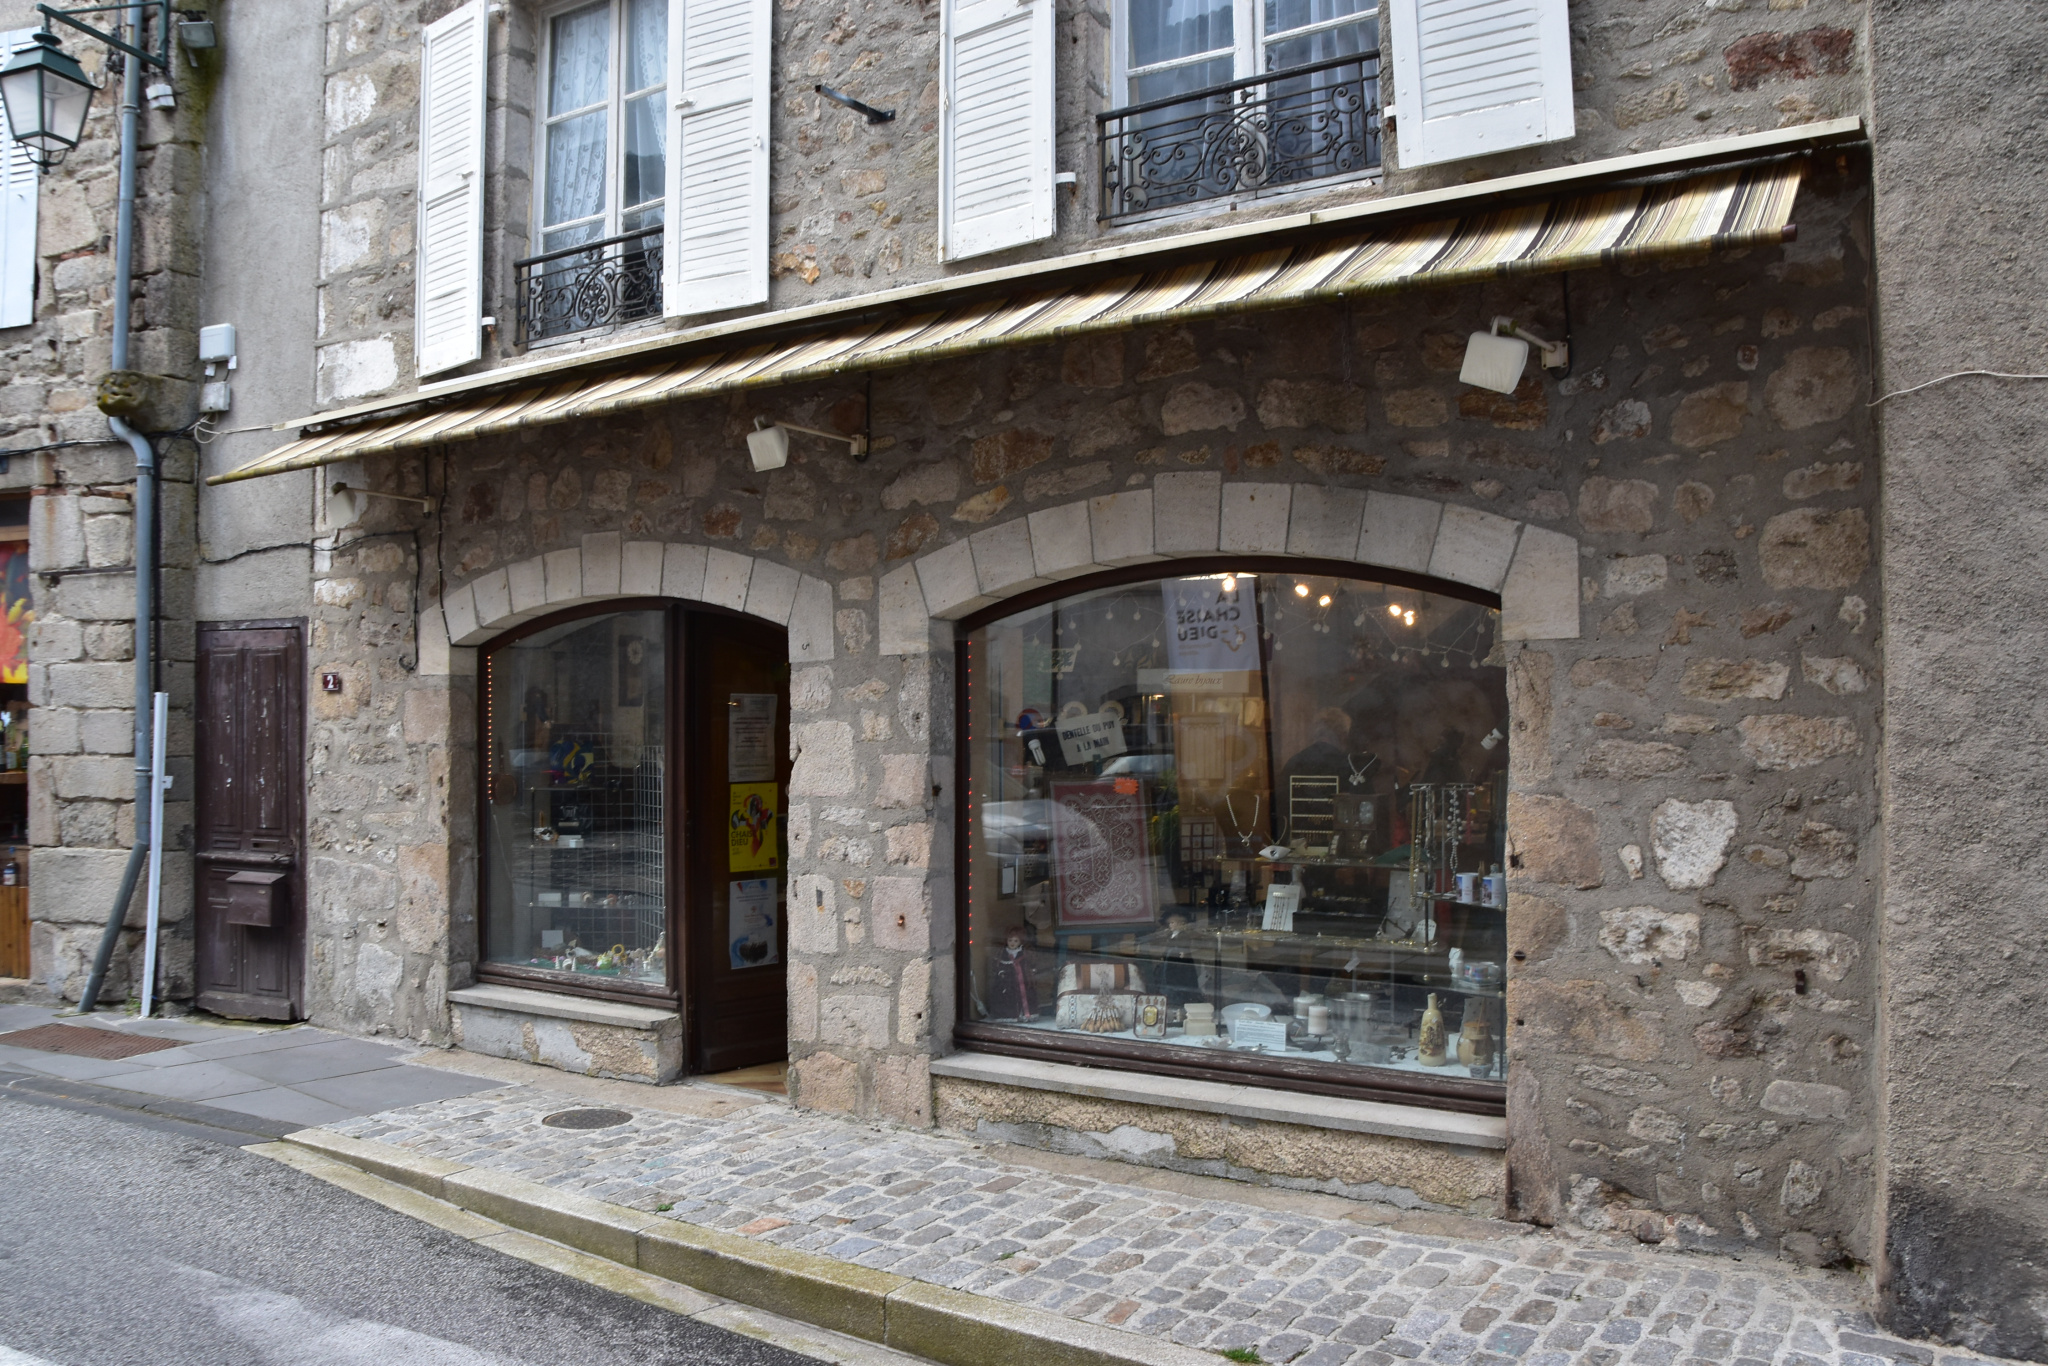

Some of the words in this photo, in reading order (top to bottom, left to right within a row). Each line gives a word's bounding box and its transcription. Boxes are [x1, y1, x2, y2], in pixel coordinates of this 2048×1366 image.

[327, 675, 334, 689] 2
[1195, 674, 1222, 688] bijoux
[1062, 725, 1090, 740] DENTELLE
[1092, 722, 1101, 733] DU
[1102, 720, 1115, 730] PUY
[1083, 741, 1091, 751] LA
[1093, 736, 1110, 748] MAIN
[731, 838, 748, 846] DIEU
